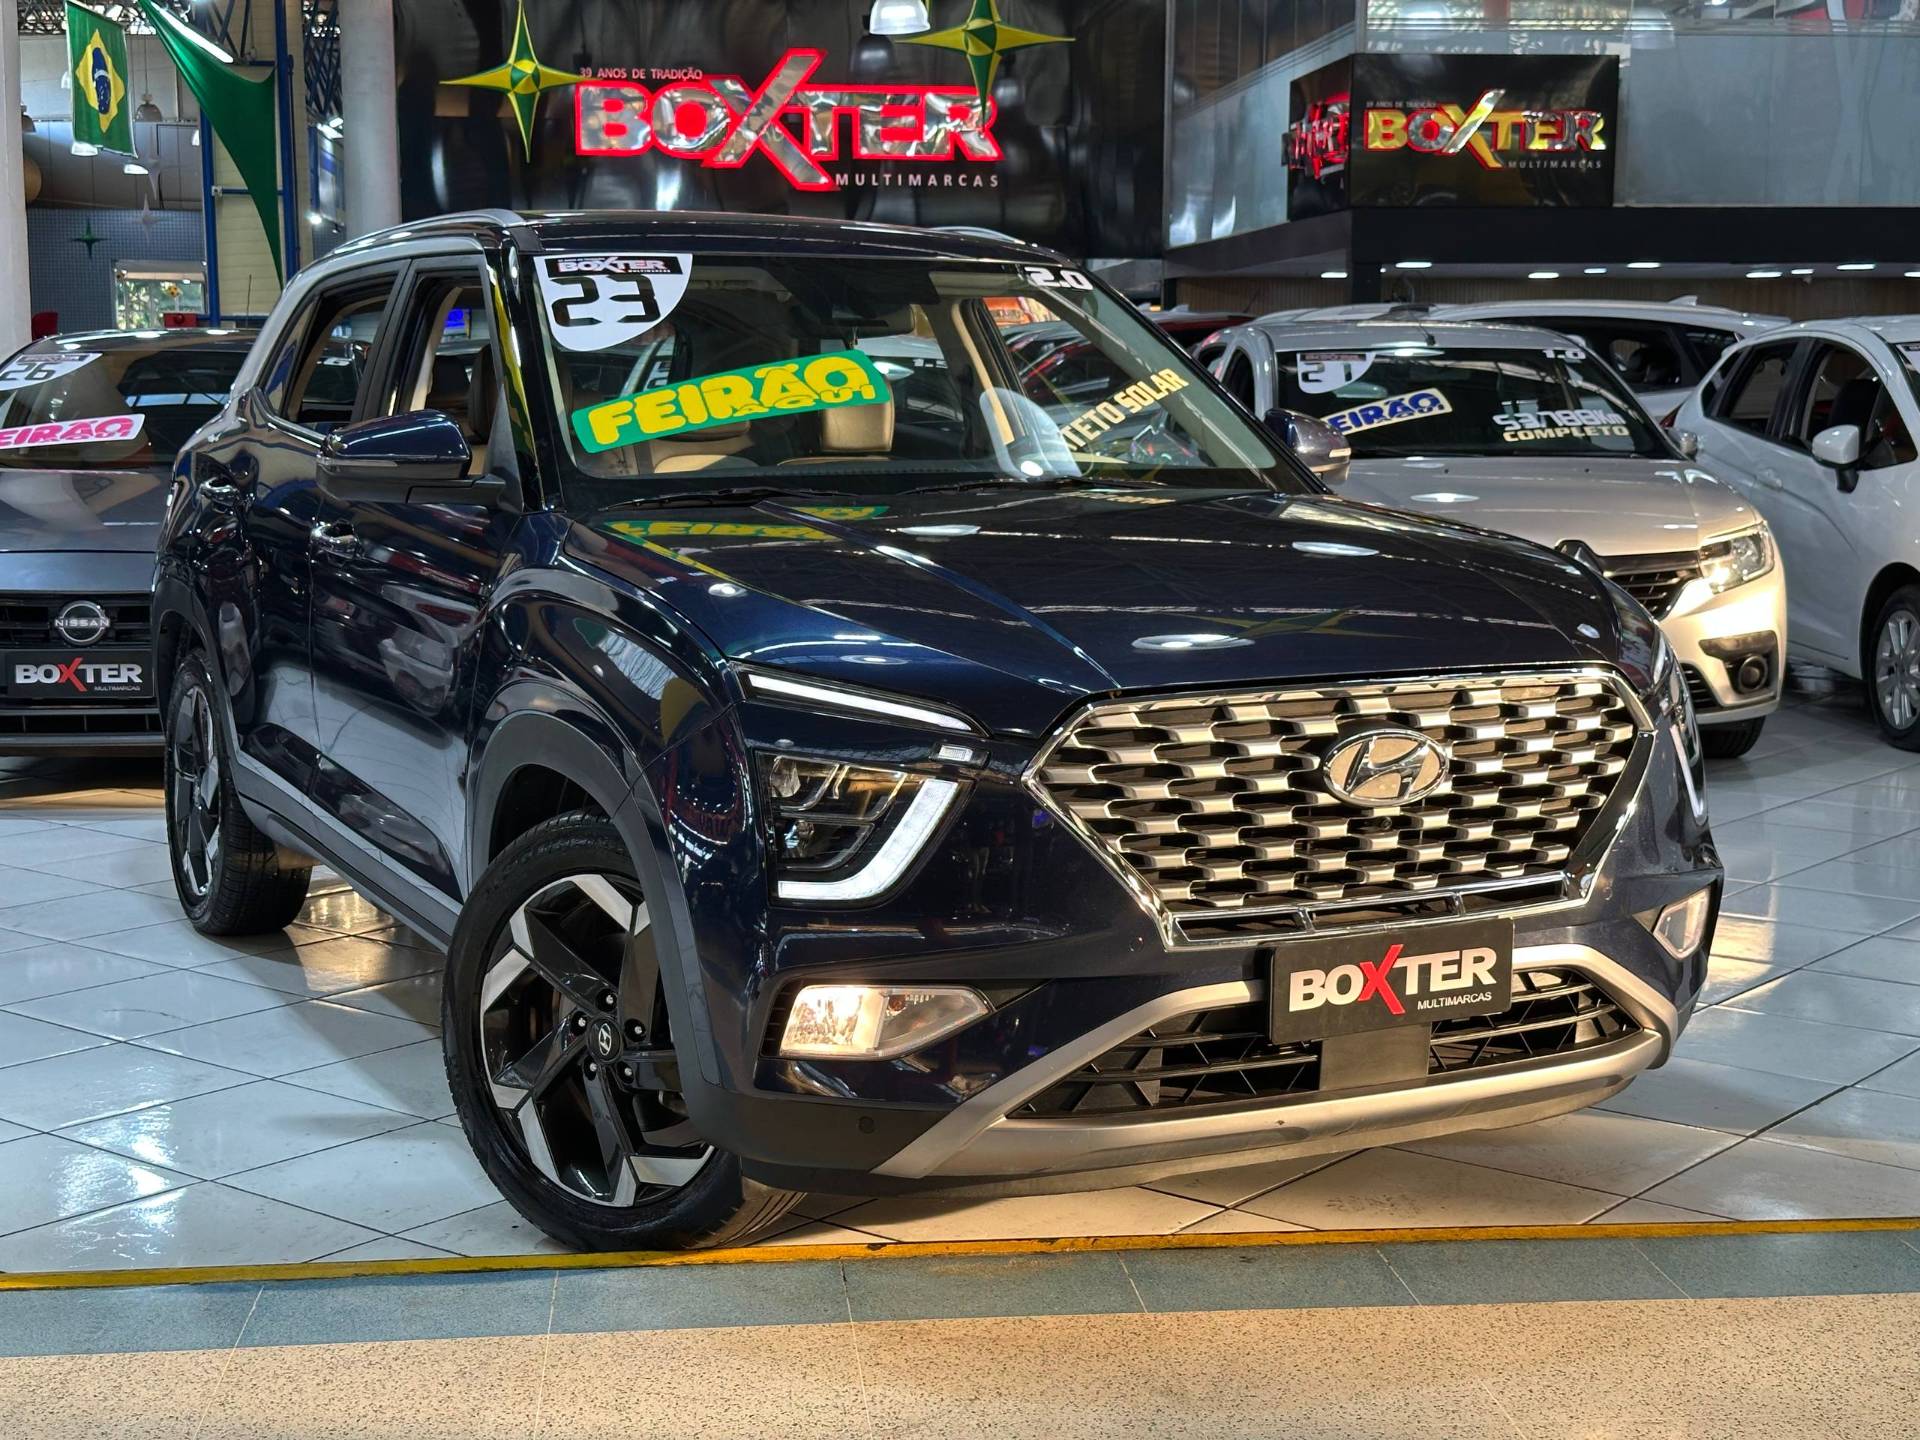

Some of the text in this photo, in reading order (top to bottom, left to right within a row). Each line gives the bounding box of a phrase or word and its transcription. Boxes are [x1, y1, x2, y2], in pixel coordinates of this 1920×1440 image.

[579, 66, 704, 81] 39 ANOS DE TRADIÇÃO
[575, 48, 1005, 191] BOXTER
[1363, 88, 1607, 170] BOXTER
[1508, 159, 1602, 169] MULTIMARCAS
[835, 173, 999, 187] MULTIMARCAS
[557, 256, 668, 273] BOXTER
[1024, 266, 1094, 291] 2.0
[550, 274, 661, 327] 23
[0, 362, 56, 381] 26
[1301, 361, 1352, 384] 21
[586, 356, 870, 446] FEIRÃO
[1113, 368, 1190, 414] SOLAR
[1328, 392, 1441, 432] EIRÃO
[0, 417, 134, 447] EIRÃO
[1502, 425, 1630, 442] COMPLETO
[54, 618, 110, 628] NISSAN
[15, 656, 143, 692] BOXTER
[1288, 943, 1498, 1016] BOXTER
[1417, 991, 1493, 1011] MULTIMARCAS
